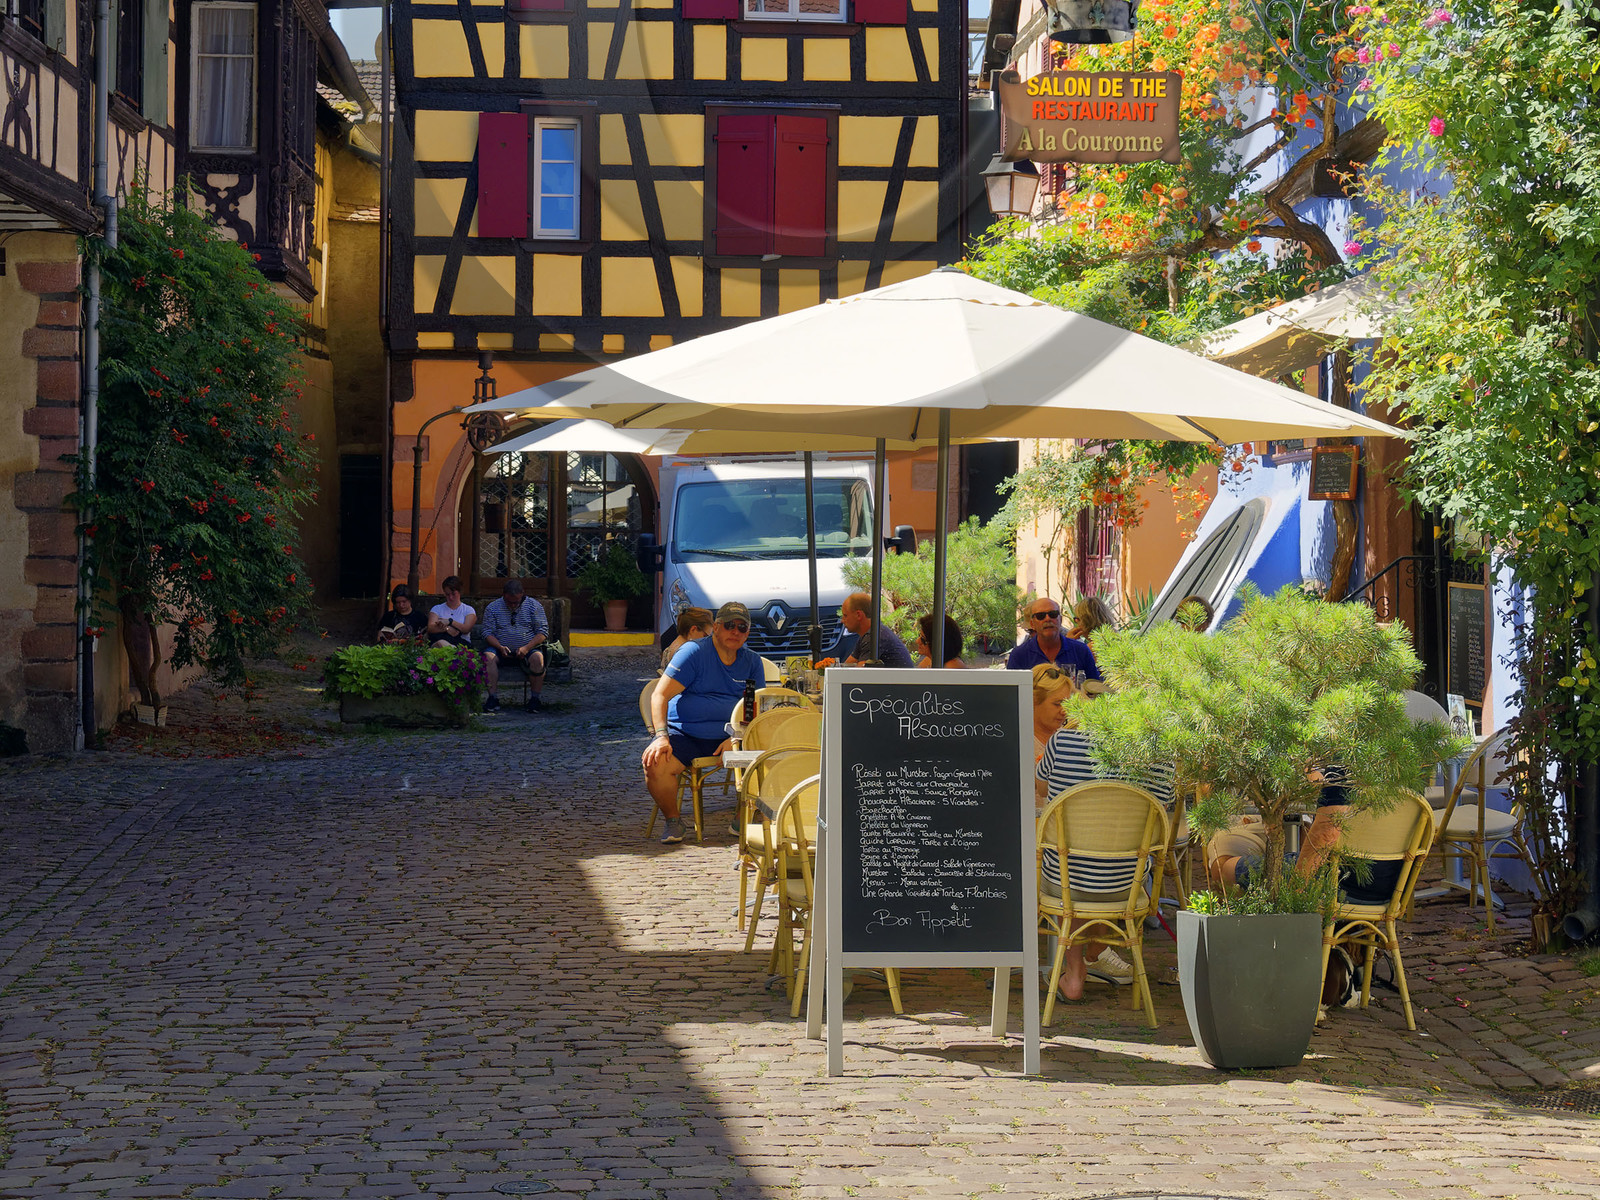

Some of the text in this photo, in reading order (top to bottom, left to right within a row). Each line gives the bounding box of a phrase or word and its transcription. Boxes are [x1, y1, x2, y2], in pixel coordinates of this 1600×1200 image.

[1026, 76, 1167, 98] SALON DE THE
[1032, 101, 1157, 121] RESTAURANT
[1018, 127, 1163, 152] A la Couronne
[849, 687, 965, 723] Spécialités
[898, 715, 1004, 740] Alsaciennes
[886, 770, 898, 778] au
[887, 779, 897, 788] de
[942, 797, 949, 806] 5
[865, 908, 973, 937] Bon Appétit
